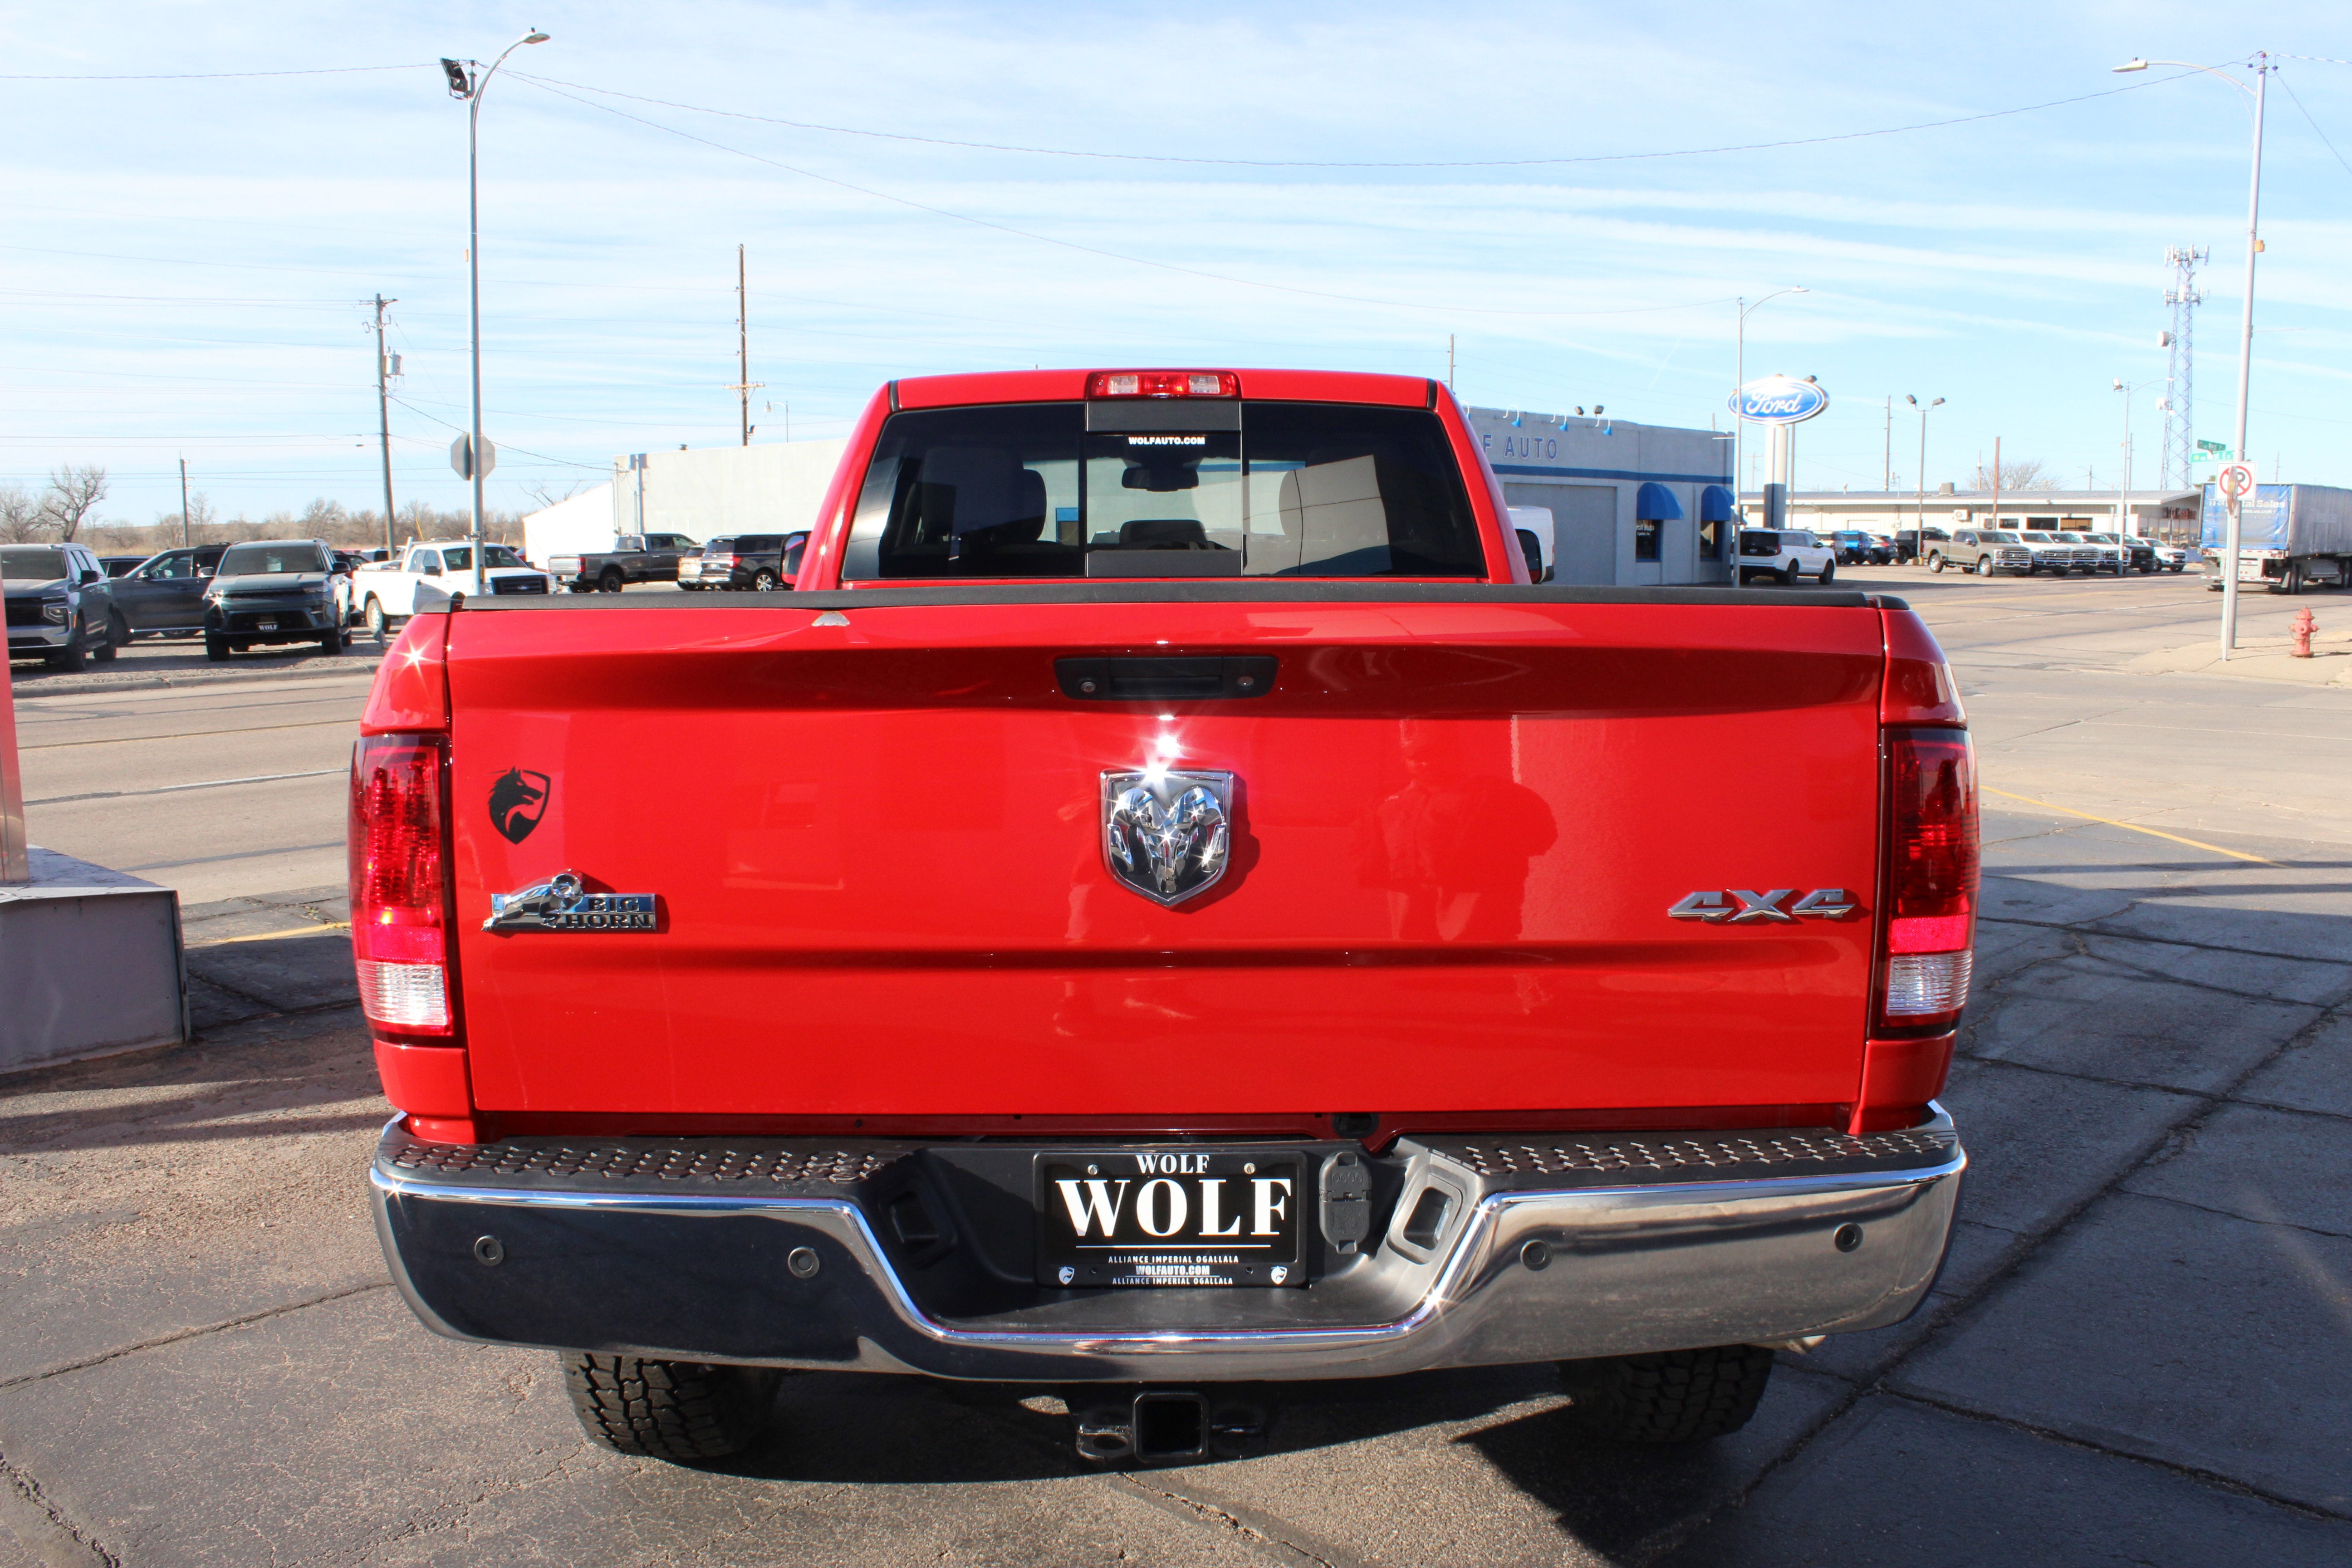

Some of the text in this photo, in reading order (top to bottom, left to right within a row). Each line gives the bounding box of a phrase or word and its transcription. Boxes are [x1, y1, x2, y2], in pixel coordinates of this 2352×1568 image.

[1746, 392, 1803, 414] Ford
[1128, 436, 1205, 445] WOLFAUTO.COM
[1503, 435, 1558, 461] AUTO
[2256, 499, 2285, 508] Sales
[588, 897, 639, 912] BIG
[565, 914, 652, 928] HORN
[1135, 1155, 1209, 1174] WOLF
[1055, 1178, 1292, 1237] WOLF
[1136, 1265, 1210, 1275] WOLFAUTO.COM
